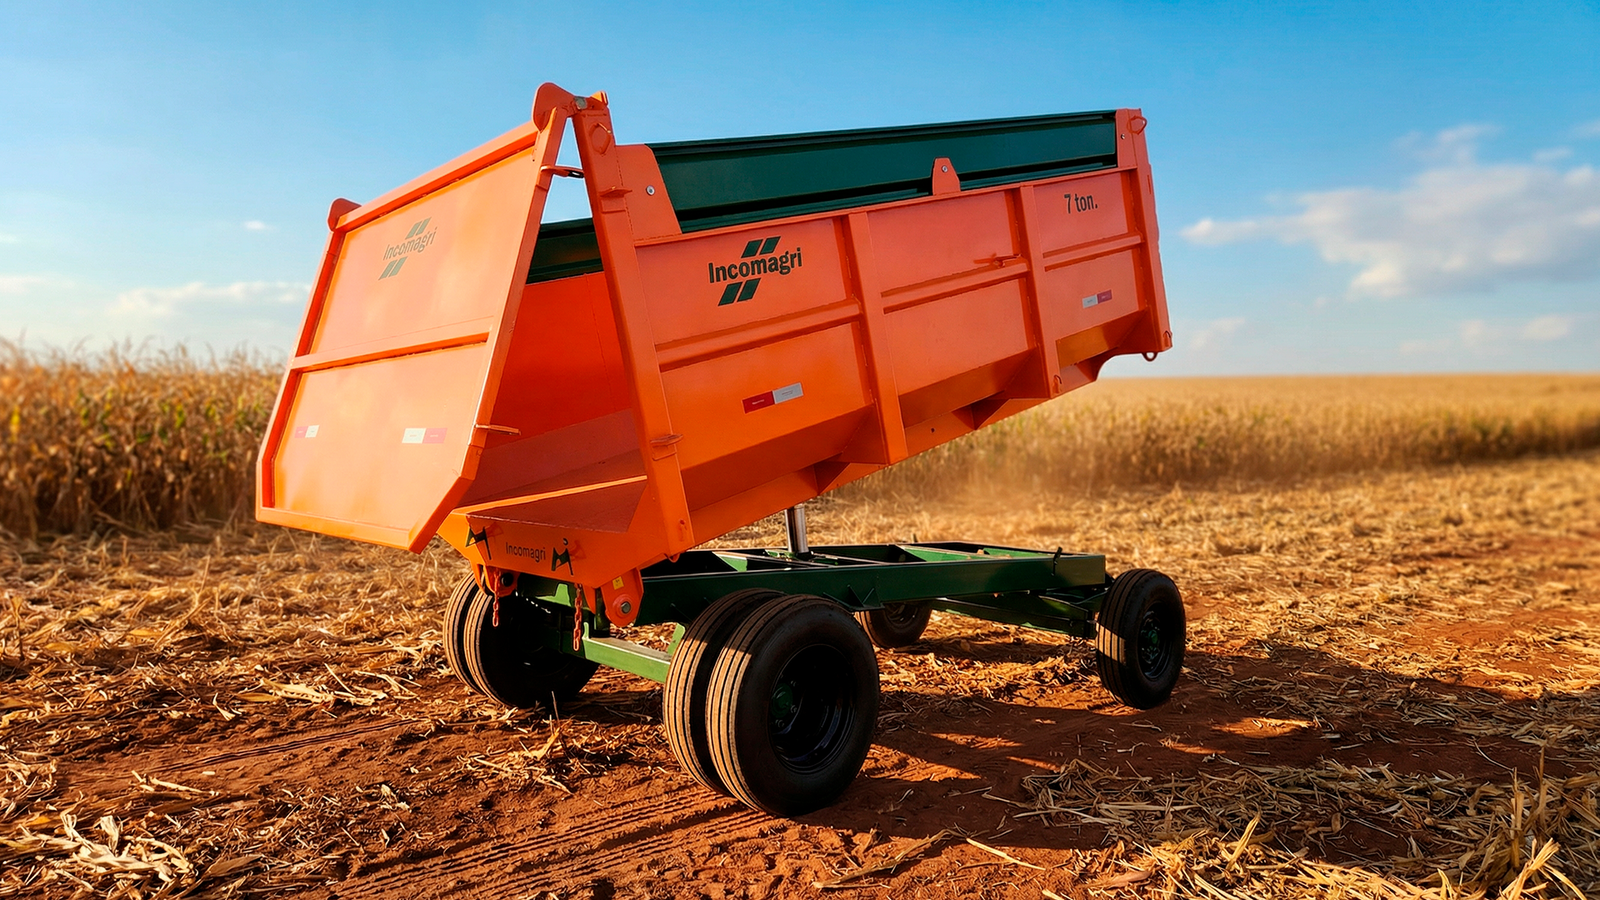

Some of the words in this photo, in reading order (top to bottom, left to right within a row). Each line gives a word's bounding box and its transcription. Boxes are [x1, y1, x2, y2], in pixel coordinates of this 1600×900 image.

[1064, 194, 1071, 214] 7
[1074, 193, 1098, 212] ton.
[382, 226, 438, 261] Incomagri
[708, 247, 802, 283] Incomagri
[505, 541, 546, 563] Incomagri
